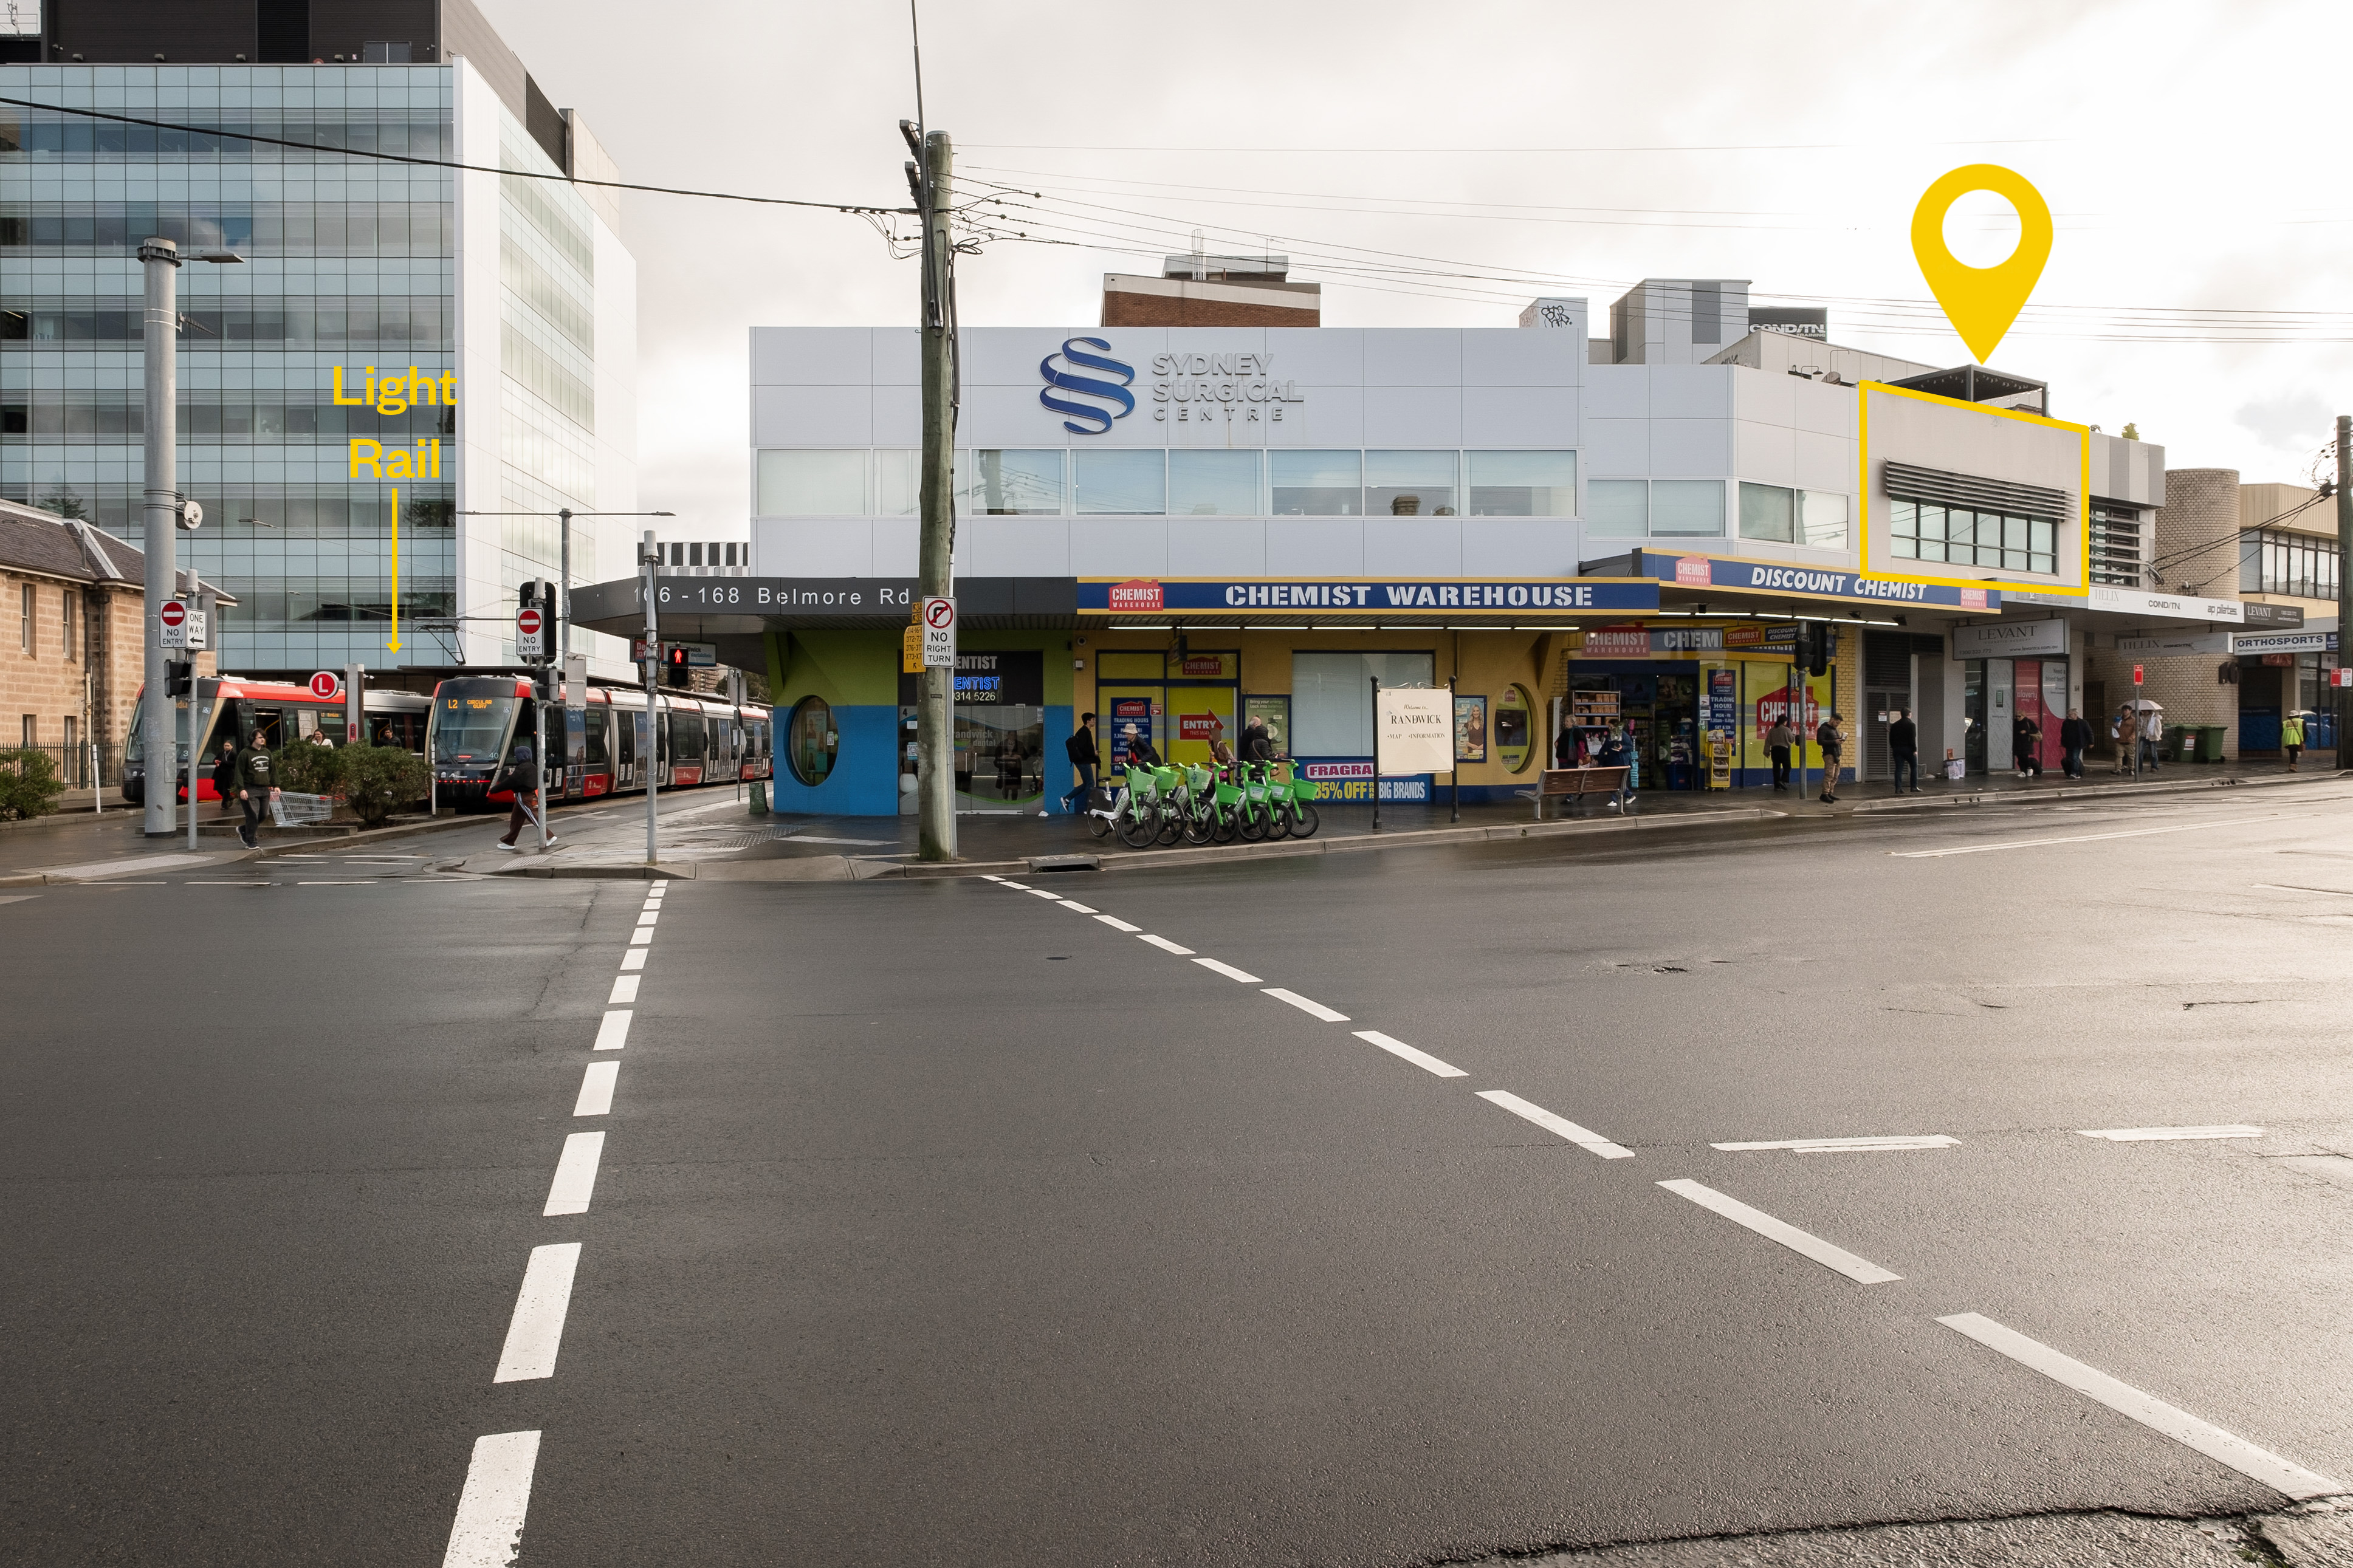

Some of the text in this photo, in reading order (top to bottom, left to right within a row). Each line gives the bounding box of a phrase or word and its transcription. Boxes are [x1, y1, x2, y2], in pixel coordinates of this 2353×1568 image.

[1153, 353, 1274, 375] SYDNEY
[1153, 380, 1304, 402] SURGICAL
[1154, 407, 1283, 421] CENTRE
[1678, 563, 1709, 577] CHEMIST
[1751, 567, 1926, 600] DISCOUNT CHEMIST
[698, 586, 740, 603] 168
[758, 587, 861, 605] Belmore
[880, 587, 909, 604] Rd
[1112, 589, 1160, 600] CHEMIST
[1226, 586, 1592, 606] CHEMIST WAREHOUSE
[1962, 589, 1985, 601] CHEMIST
[2095, 589, 2119, 601] HELIX
[2247, 606, 2272, 617] LEVANT
[190, 614, 203, 623] ONE
[189, 625, 204, 634] WAY
[1978, 626, 2038, 640] LEVANT
[931, 632, 947, 642] NO
[1585, 632, 1646, 645] CHEMIST
[1664, 632, 1722, 648] CHEM
[2238, 635, 2323, 647] ORTHOSPORTS
[2123, 640, 2160, 649] HELIX
[956, 656, 997, 669] ENTIST
[319, 677, 329, 693] L
[954, 677, 1000, 690] ENTIST
[953, 692, 995, 700] 314 5226
[448, 700, 458, 709] L2
[902, 708, 907, 716] 4
[1761, 701, 1815, 723] CHEMIT
[1183, 721, 1217, 729] ENTRY
[1391, 715, 1441, 724] RANDWICK
[954, 730, 993, 739] andwick
[1310, 765, 1372, 776] FRAGRA
[1344, 782, 1367, 799] OFF
[1379, 782, 1391, 799] BIG
[1393, 782, 1424, 799] BRANDS
